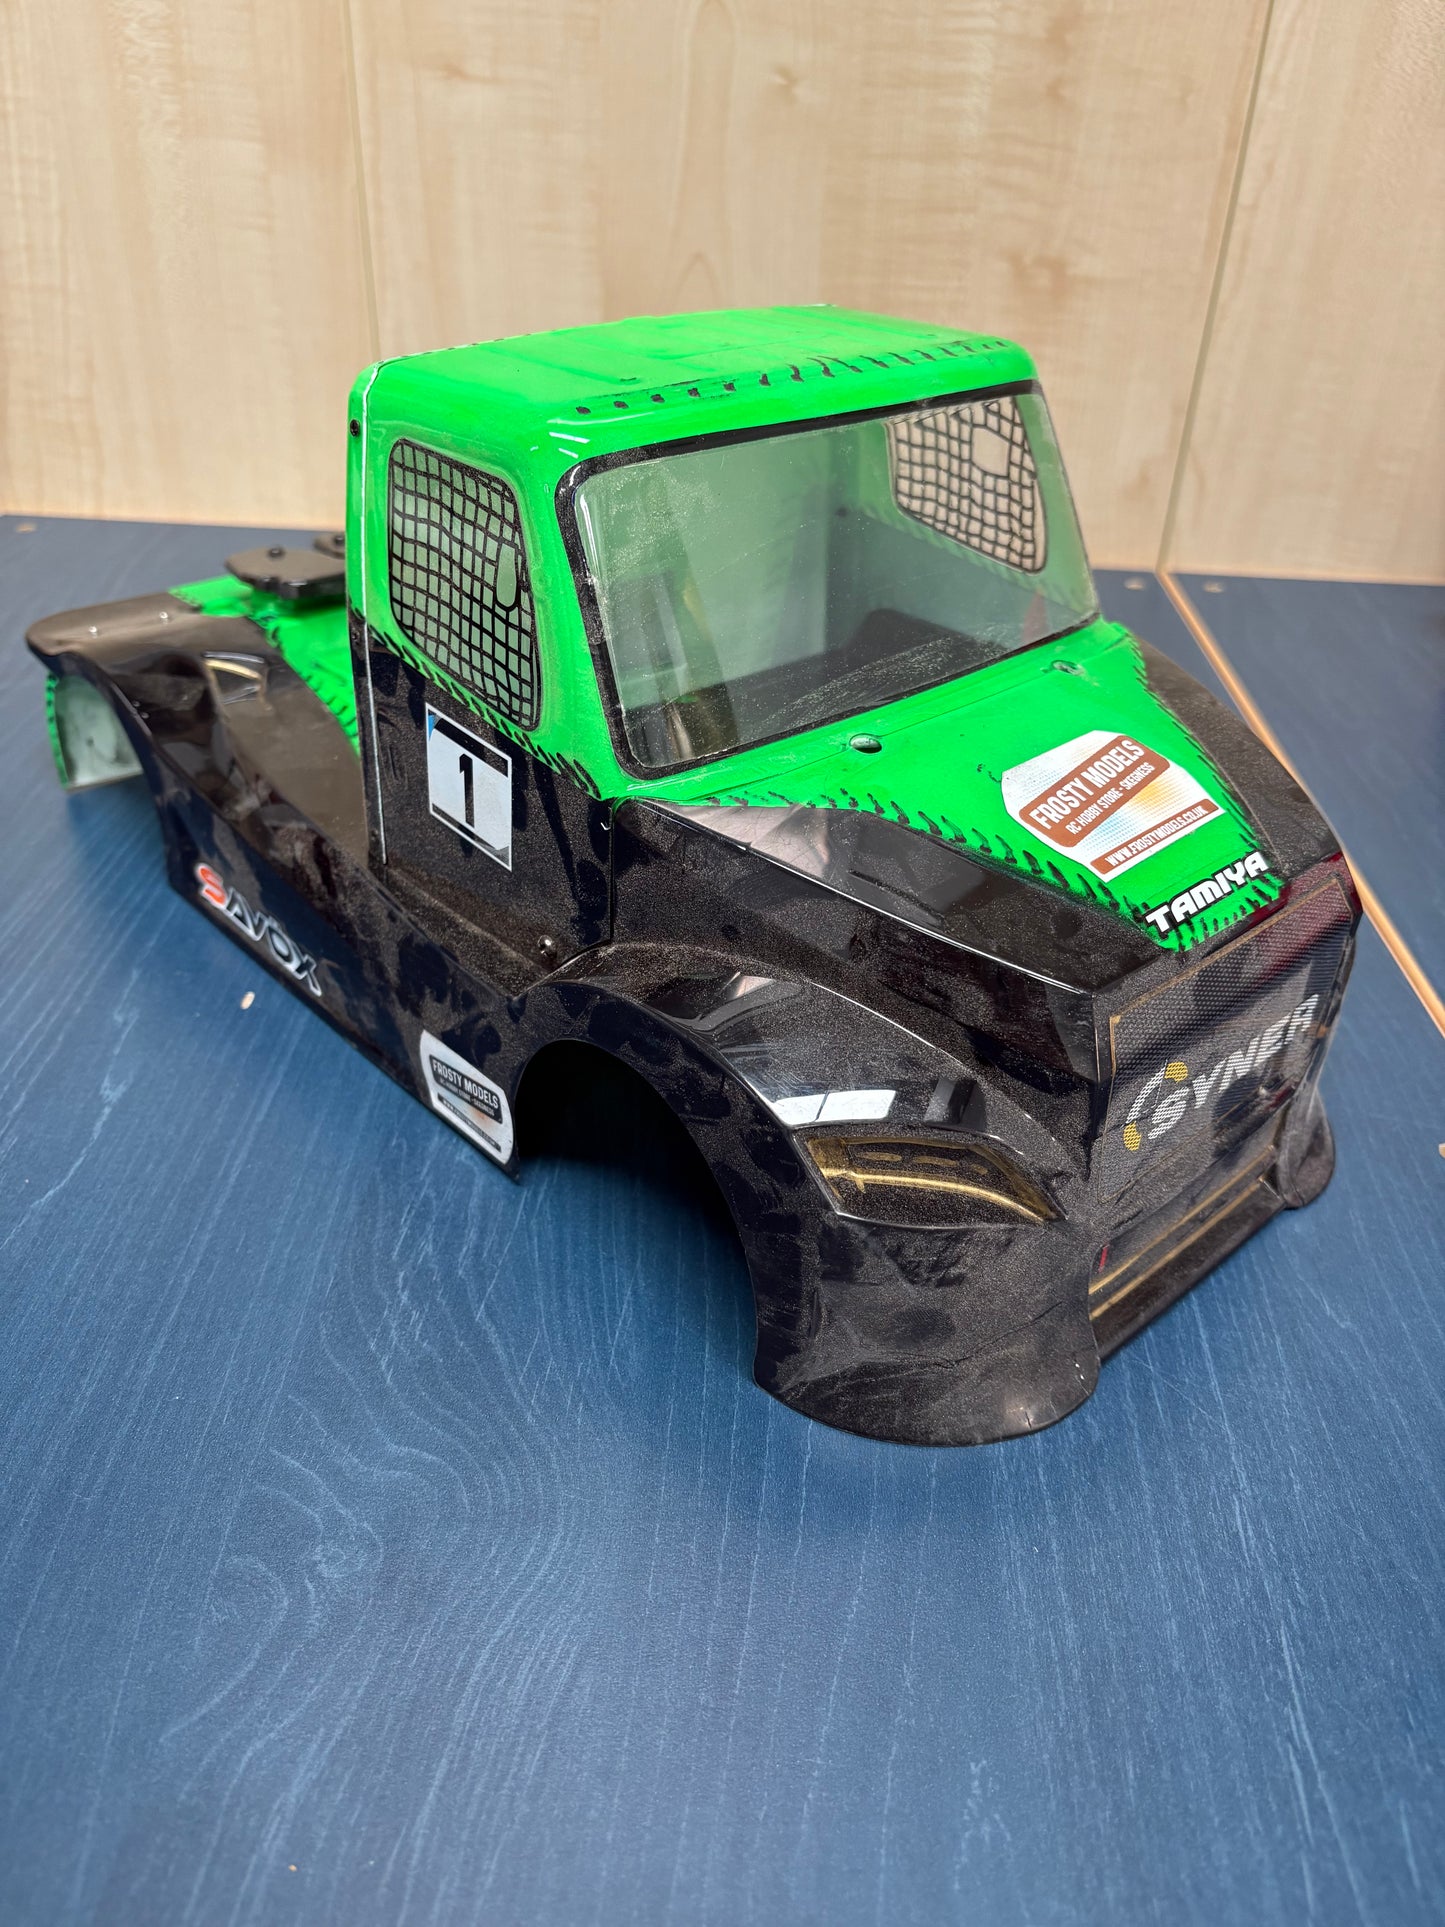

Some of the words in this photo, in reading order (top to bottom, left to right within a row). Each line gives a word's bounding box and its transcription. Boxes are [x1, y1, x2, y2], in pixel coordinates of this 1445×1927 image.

[459, 753, 475, 828] 1
[1029, 777, 1094, 829] FROSTY
[1080, 740, 1145, 788] MODELS
[1065, 821, 1082, 835] RC
[1074, 802, 1103, 827] HOBBY
[1096, 787, 1123, 809] STORE
[1119, 762, 1155, 790] SKEGNESS
[1104, 805, 1209, 867] WWW.FROSTYMODELS.CO.UK
[1144, 850, 1270, 933] TAMIYA
[432, 1059, 463, 1088] FROSTY
[463, 1078, 499, 1110] MODELS
